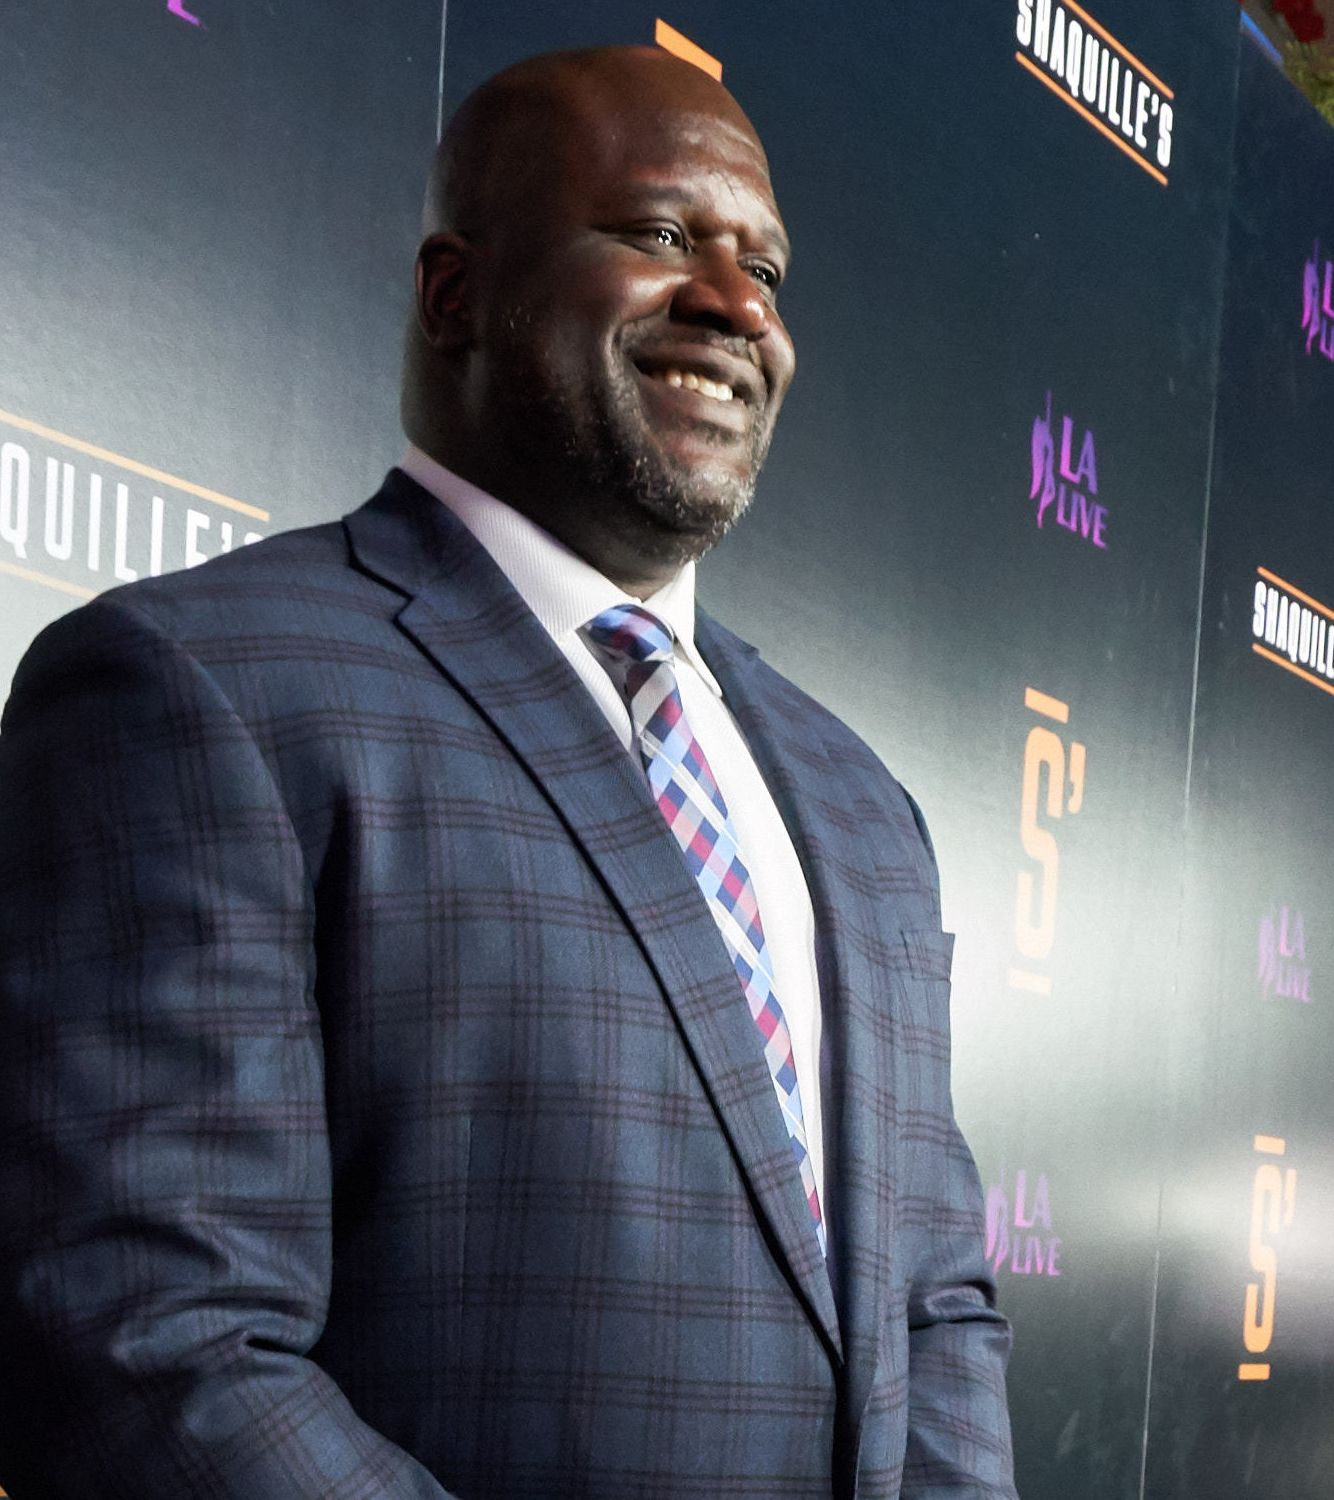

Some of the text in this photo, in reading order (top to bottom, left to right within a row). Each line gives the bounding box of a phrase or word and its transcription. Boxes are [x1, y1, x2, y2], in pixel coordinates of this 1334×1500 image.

[1060, 415, 1098, 495] LA
[1056, 482, 1109, 550] LIVE
[1014, 1168, 1052, 1230] LA
[1010, 1235, 1063, 1277] LIVE
